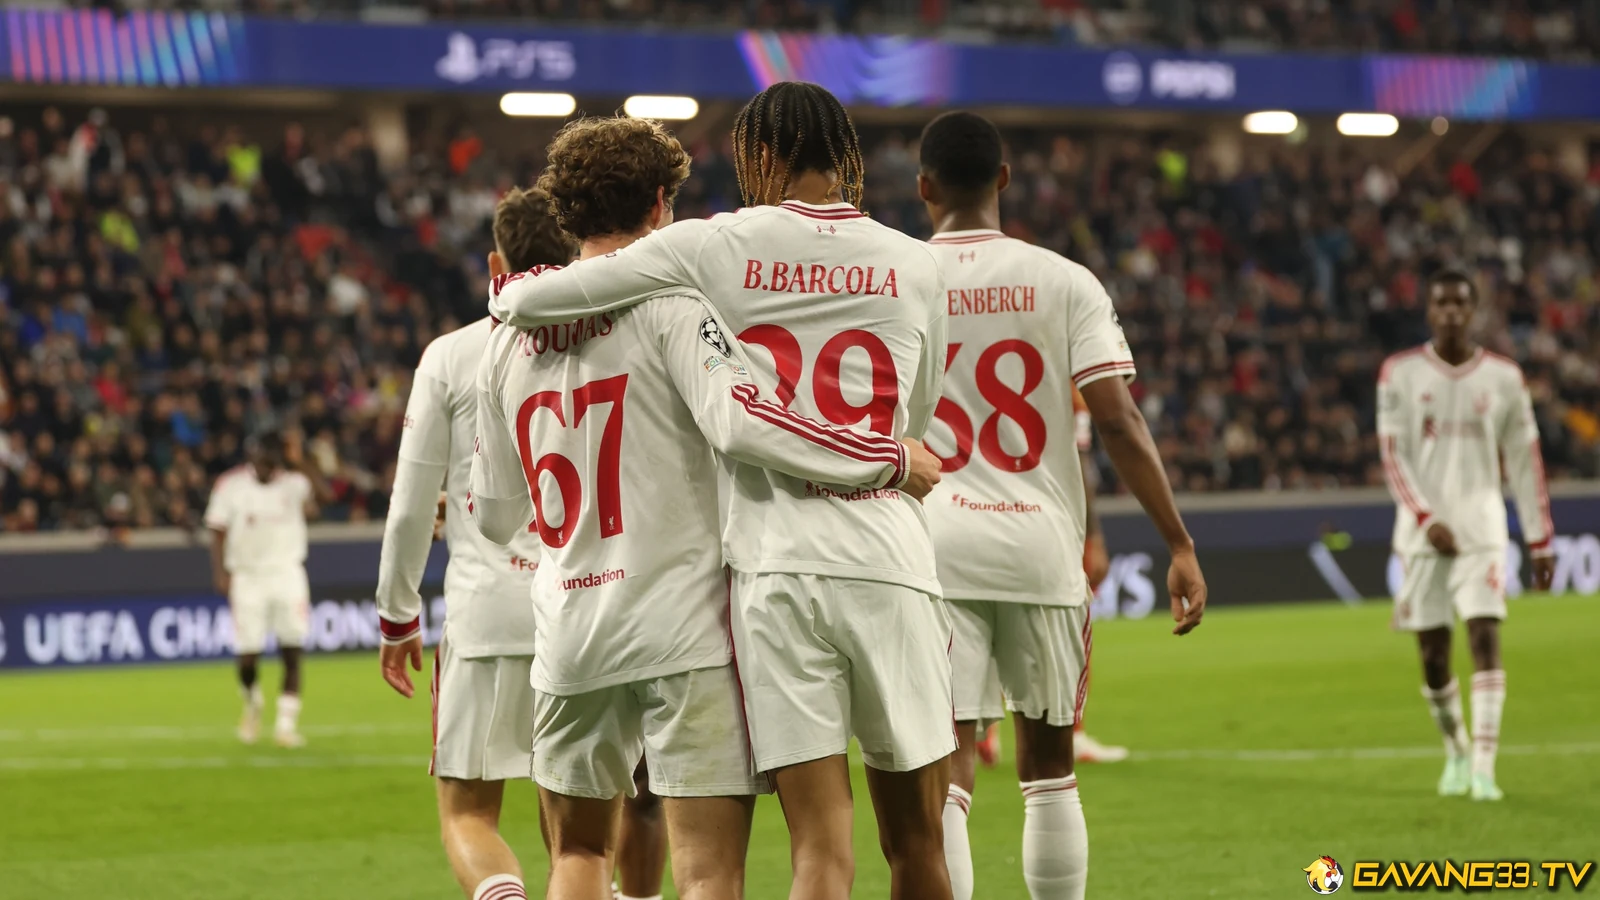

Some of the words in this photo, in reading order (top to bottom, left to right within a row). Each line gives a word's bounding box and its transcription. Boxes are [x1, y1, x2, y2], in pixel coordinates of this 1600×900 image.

[743, 259, 899, 298] B.BARCOLA
[947, 286, 1035, 316] ENBERCH
[516, 373, 629, 549] 67
[960, 497, 1042, 513] Foundation
[556, 568, 625, 590] undation
[24, 611, 146, 664] UEFA
